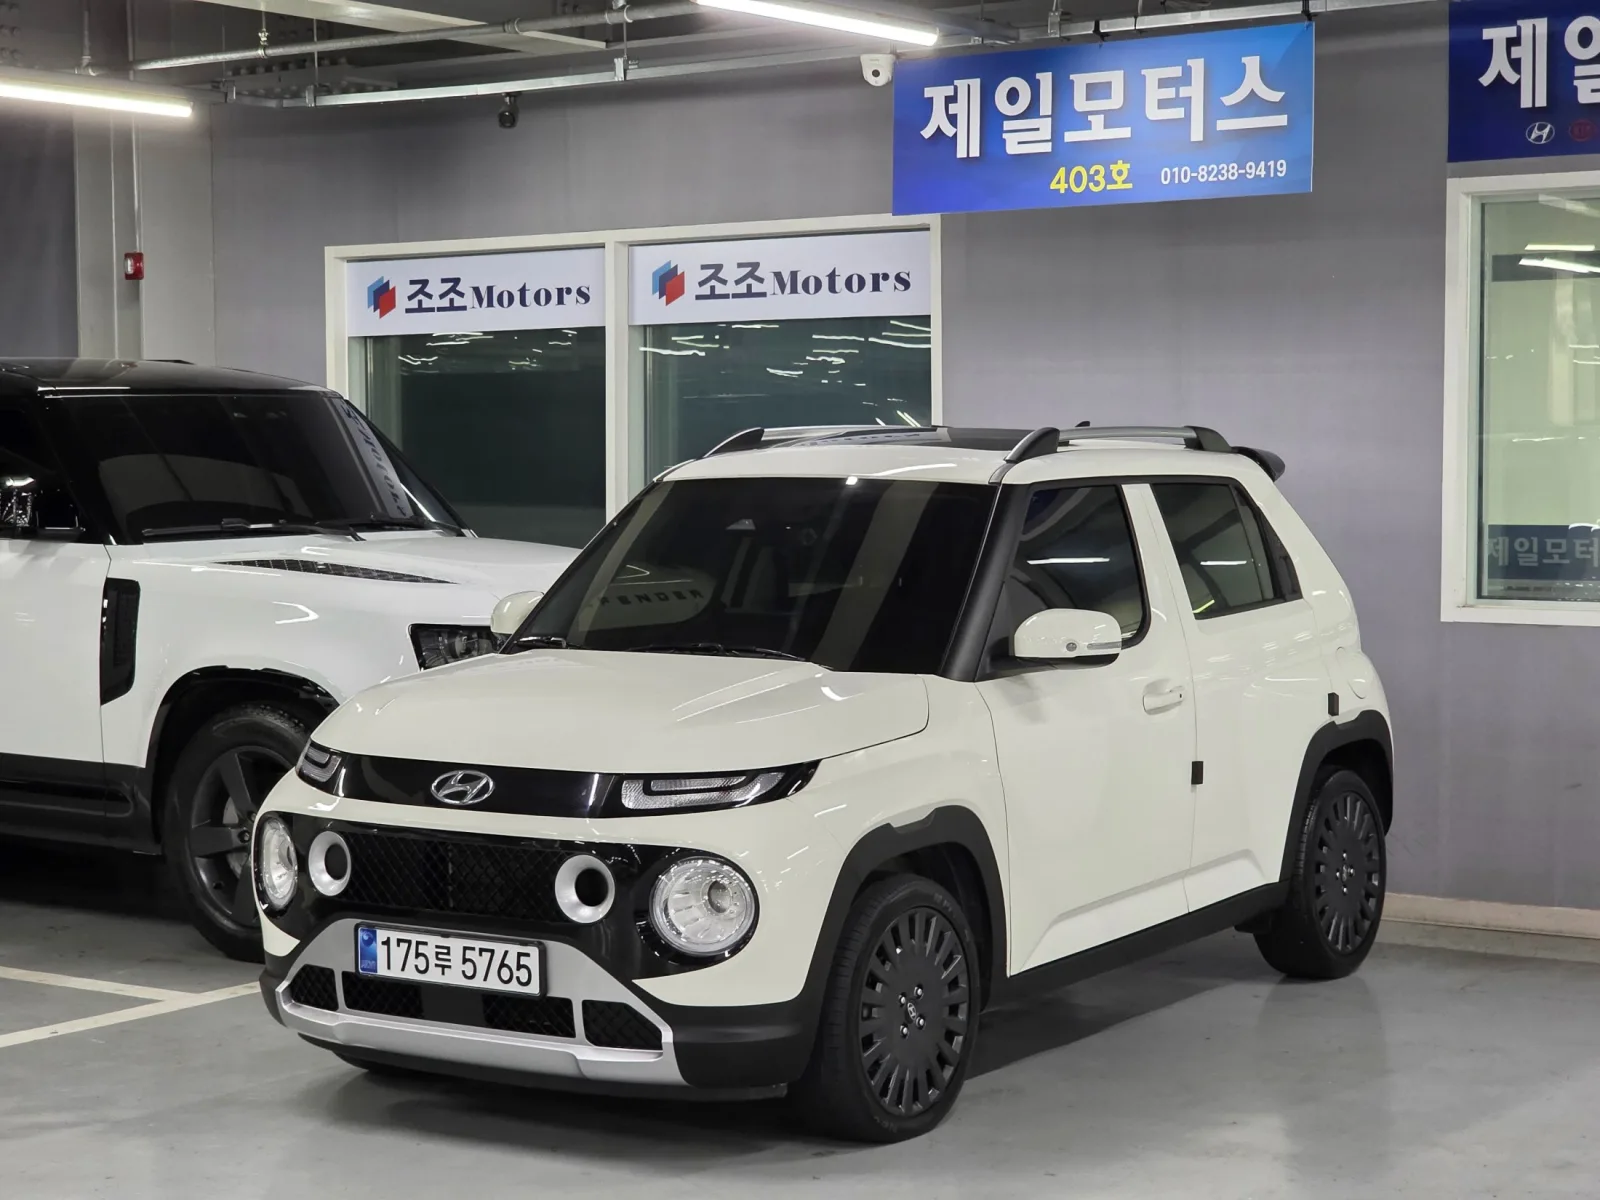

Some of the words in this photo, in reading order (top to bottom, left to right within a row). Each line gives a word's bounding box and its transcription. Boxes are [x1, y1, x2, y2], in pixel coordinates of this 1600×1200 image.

[920, 55, 1288, 158] 제일모터스
[1050, 159, 1133, 194] 403호
[1160, 159, 1287, 185] 010-8238-9419
[381, 936, 452, 976] 175루
[461, 945, 532, 987] 5765
